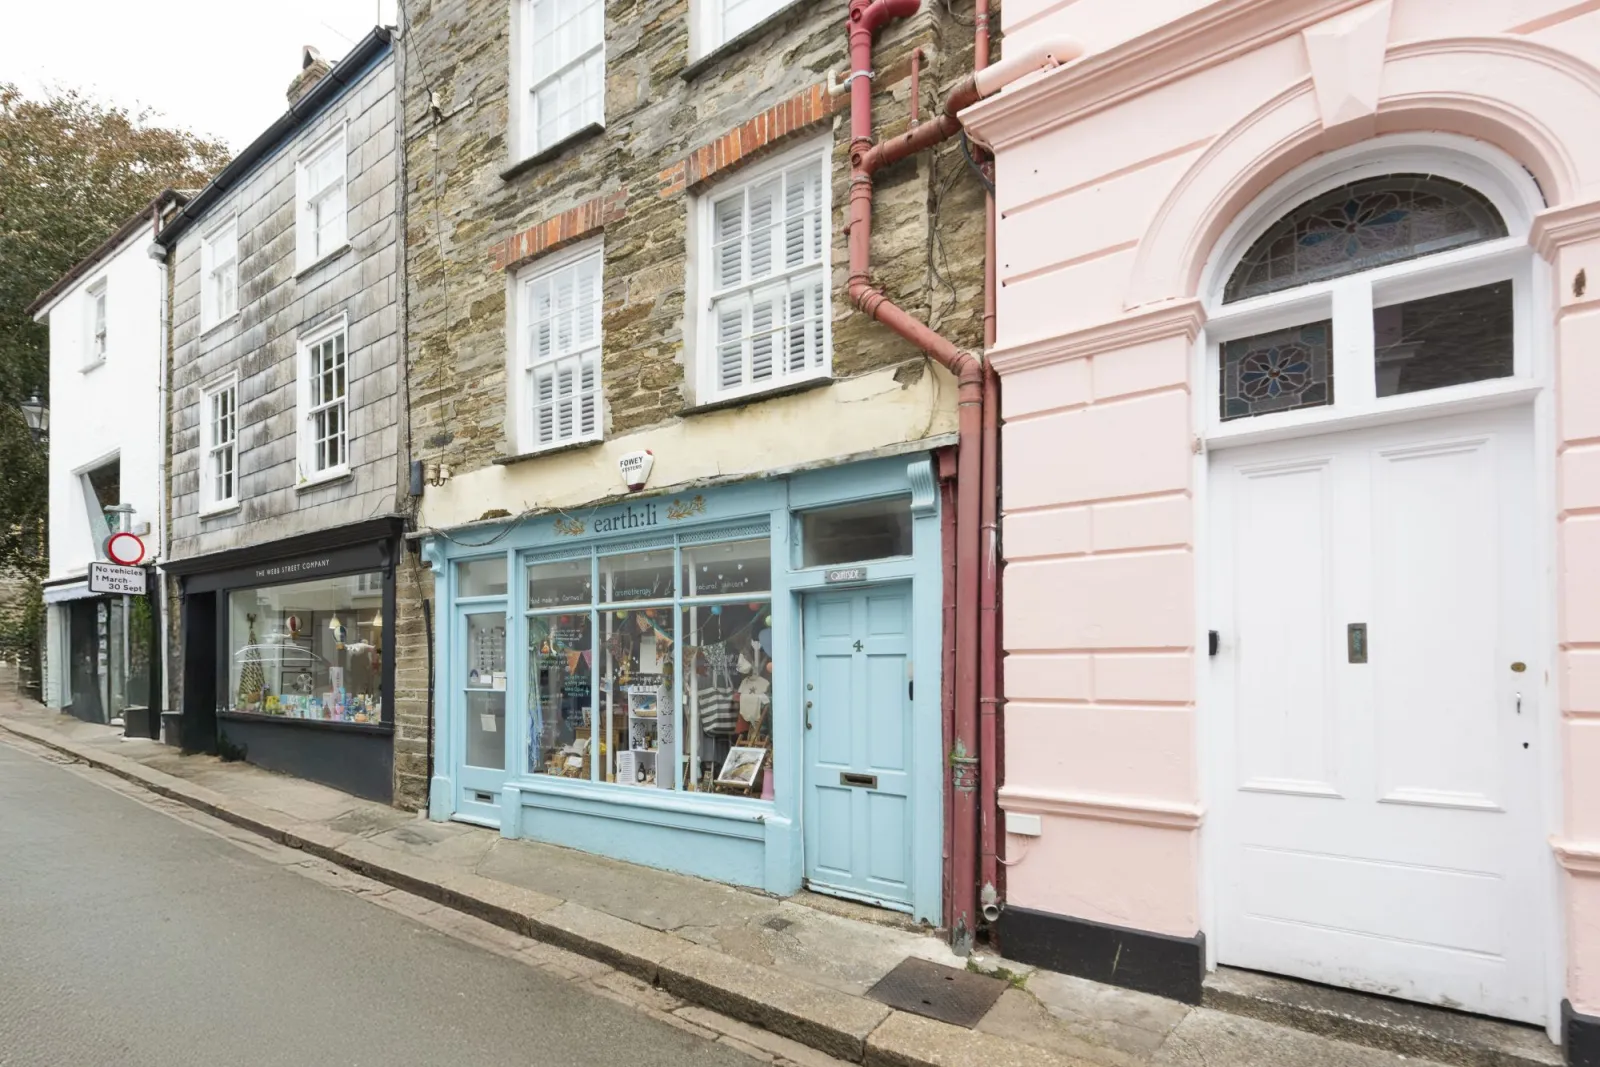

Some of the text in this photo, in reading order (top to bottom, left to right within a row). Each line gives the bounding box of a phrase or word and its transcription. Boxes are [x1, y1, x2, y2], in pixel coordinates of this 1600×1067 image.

[620, 456, 643, 467] FOWEY
[594, 503, 657, 533] earth:li
[281, 564, 300, 573] STREET
[302, 559, 329, 570] COMPANY
[110, 568, 143, 576] vehicles
[123, 584, 142, 592] Sept
[614, 588, 652, 597] aromatherapy
[852, 639, 864, 653] 4
